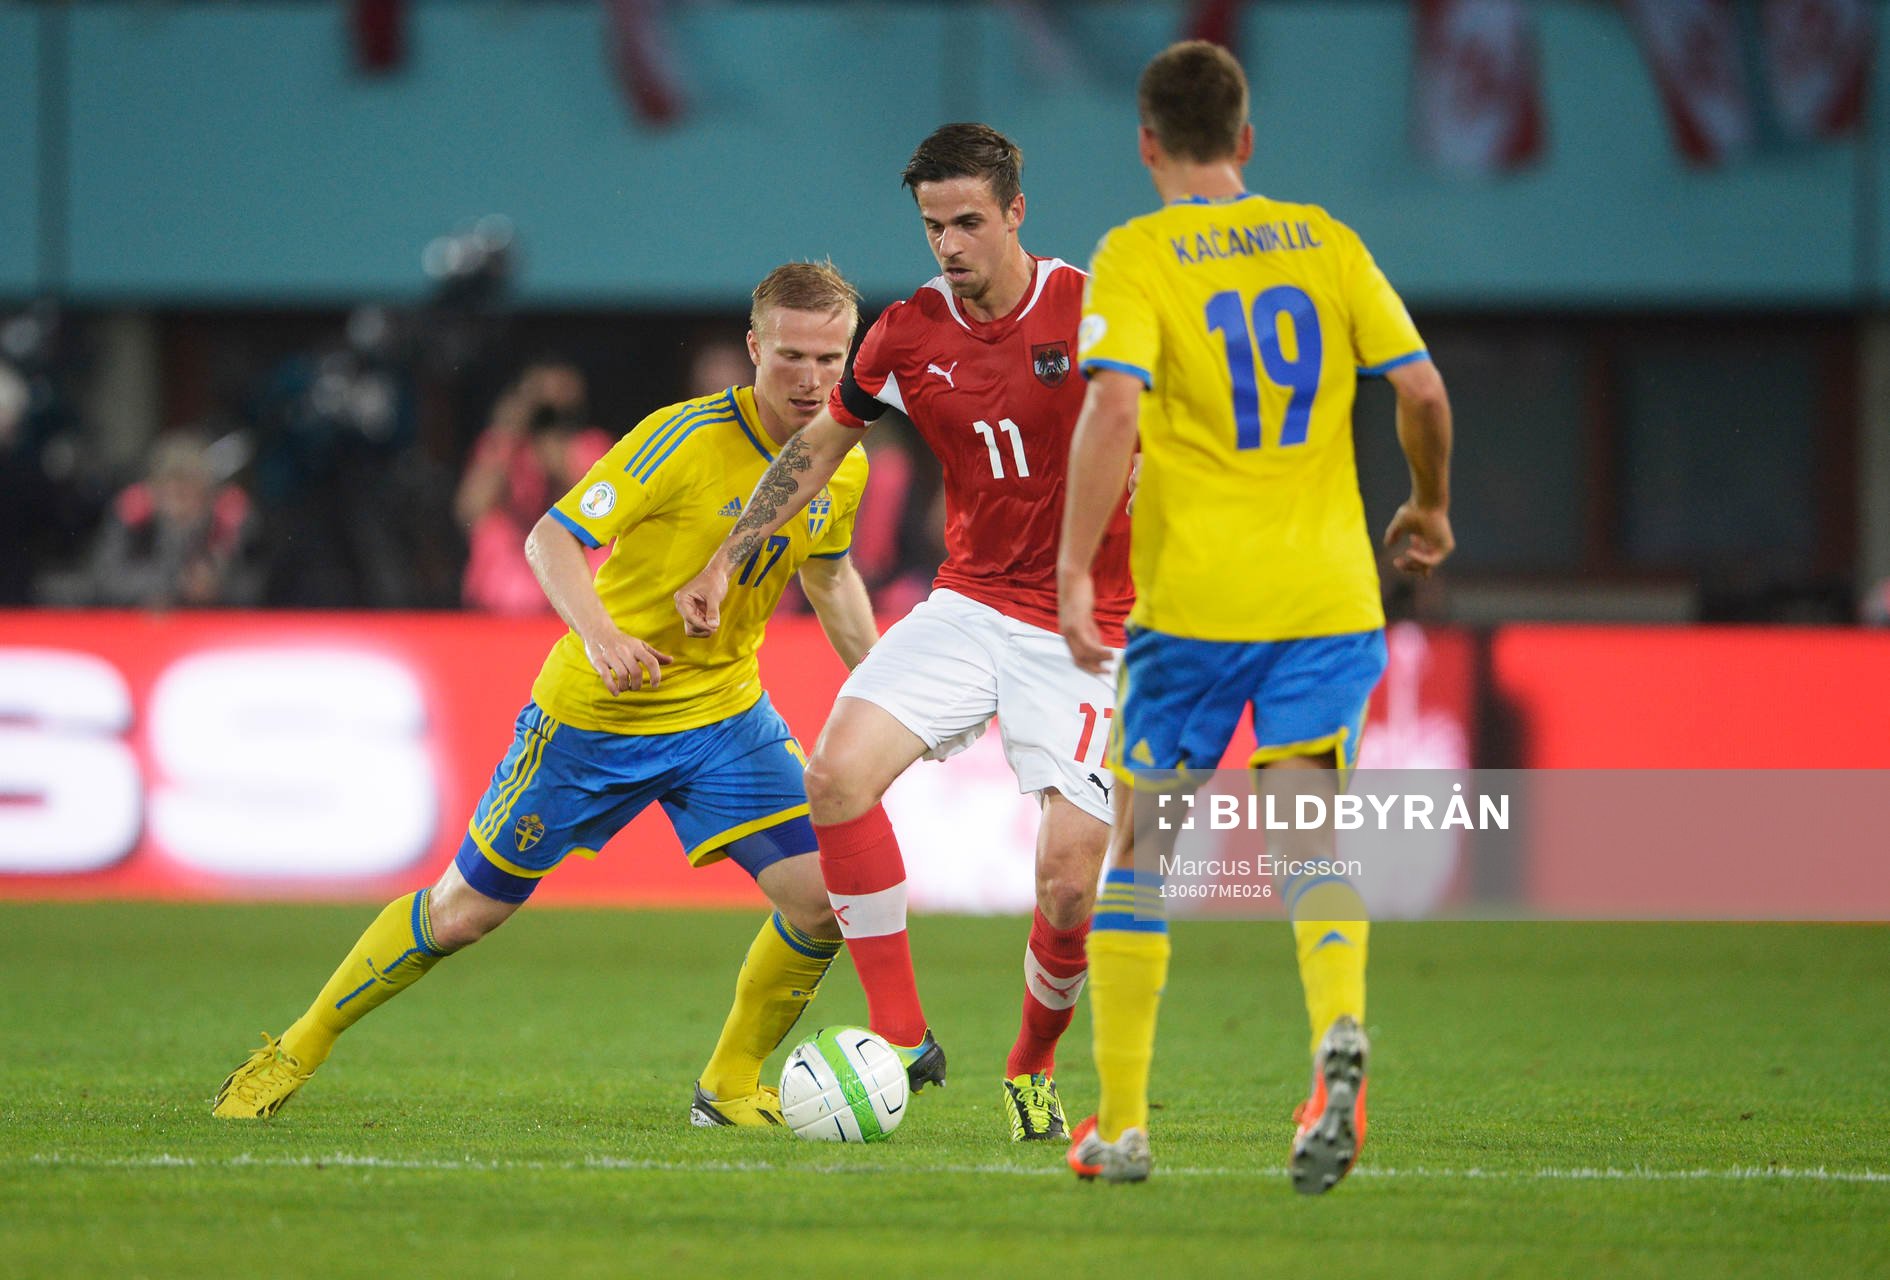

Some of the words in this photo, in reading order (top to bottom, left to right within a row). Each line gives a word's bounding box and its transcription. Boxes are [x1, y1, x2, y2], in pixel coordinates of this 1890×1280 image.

[1205, 285, 1323, 450] 19
[972, 418, 1030, 479] 11
[738, 535, 791, 588] 17
